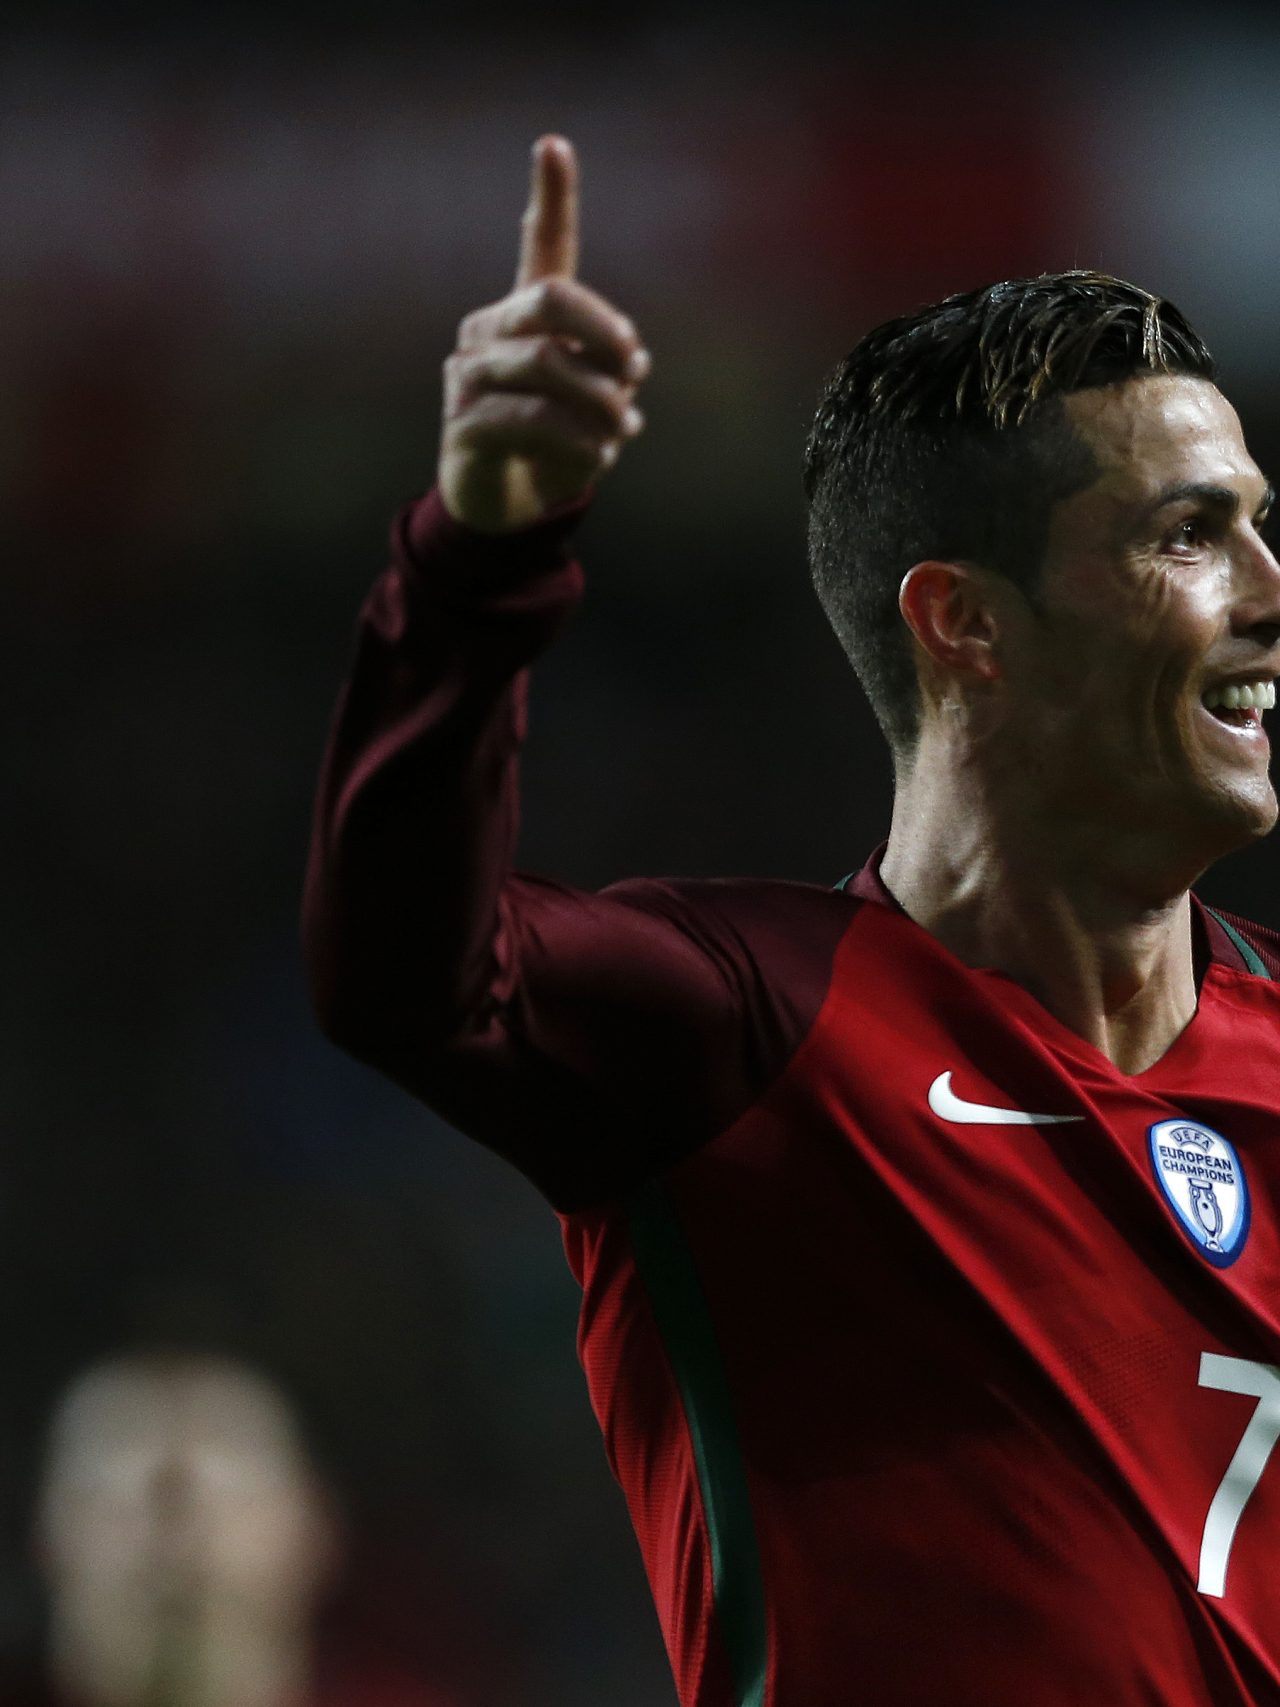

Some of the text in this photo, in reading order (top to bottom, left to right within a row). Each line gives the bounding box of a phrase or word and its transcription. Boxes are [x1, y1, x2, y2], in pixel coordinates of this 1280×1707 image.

[1173, 1129, 1212, 1150] UEFA
[1159, 1145, 1233, 1171] EUROPEAN
[1162, 1159, 1235, 1185] CHAMPIONS
